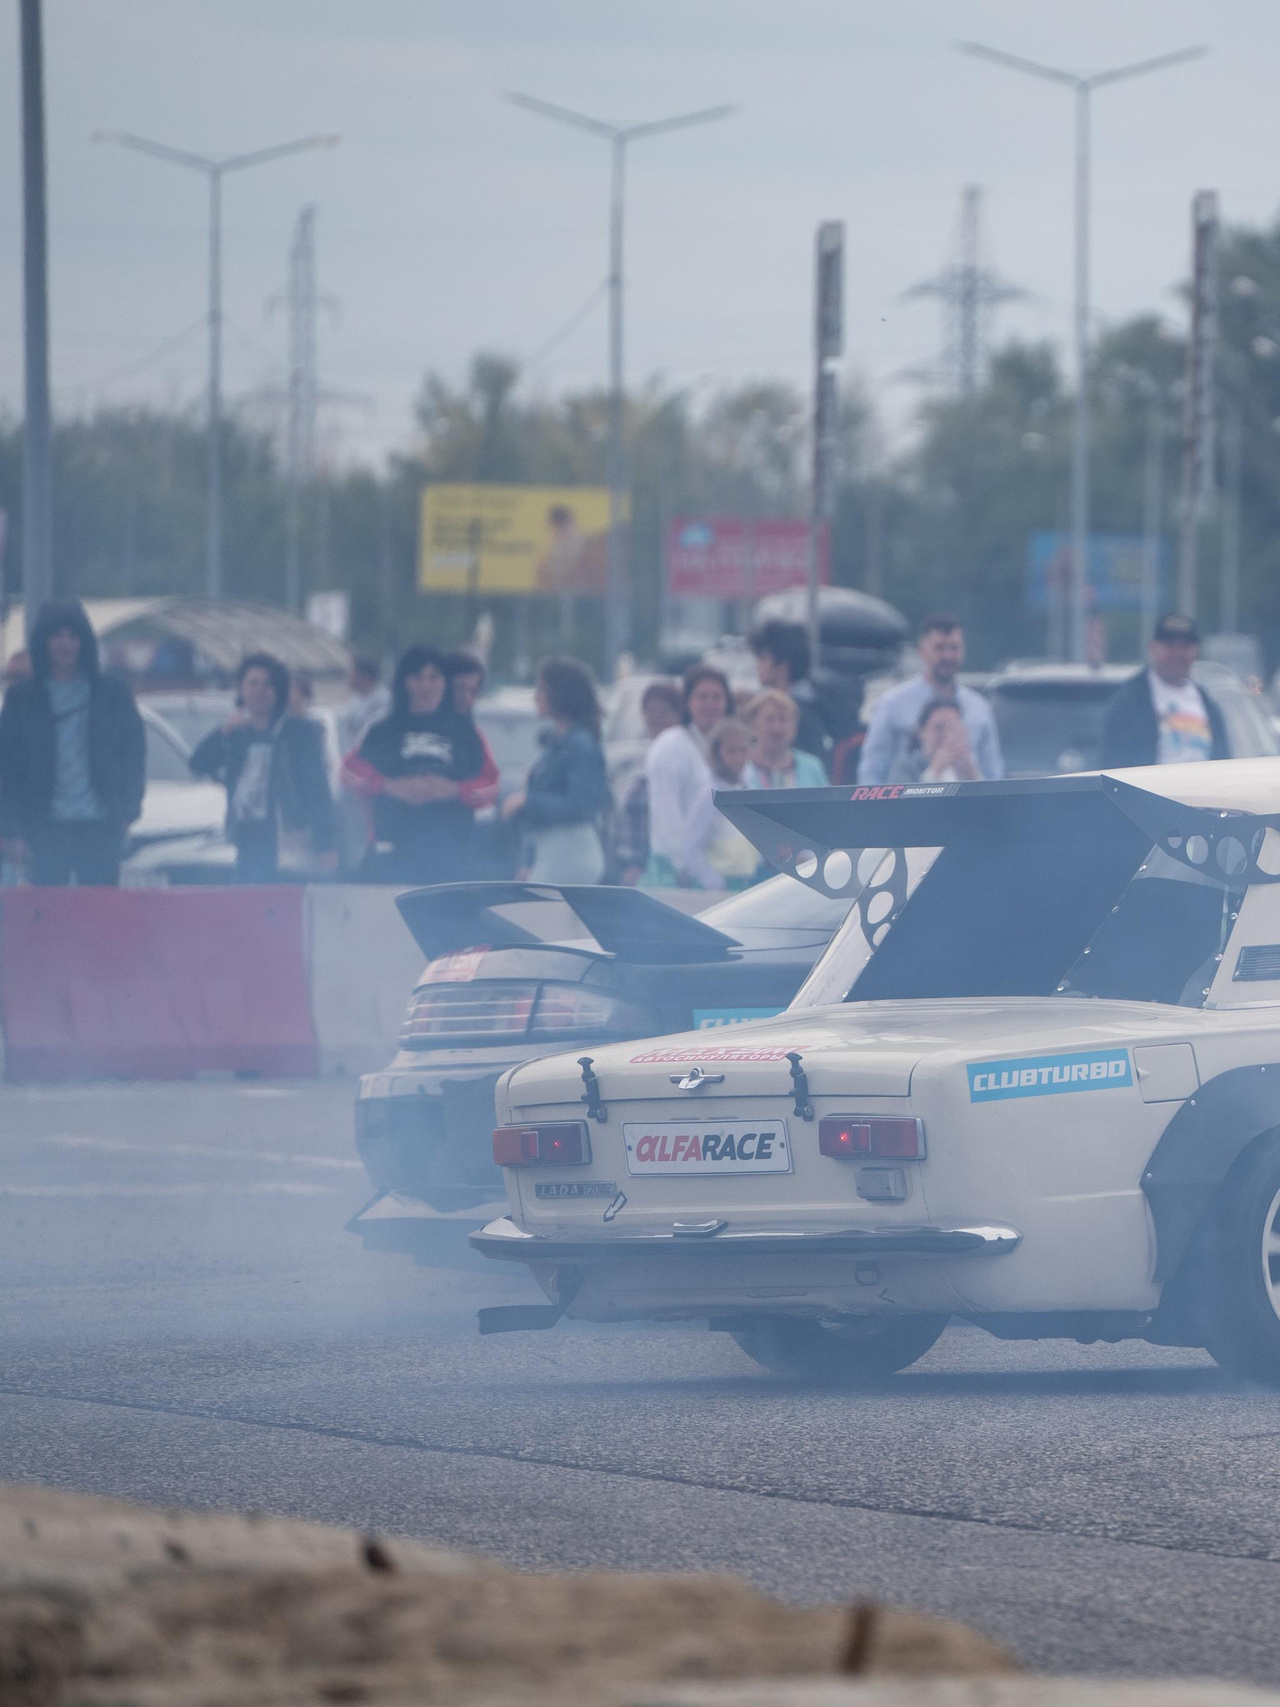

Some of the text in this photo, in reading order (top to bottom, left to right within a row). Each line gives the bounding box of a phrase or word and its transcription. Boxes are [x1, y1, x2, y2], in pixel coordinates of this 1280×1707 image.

[850, 785, 945, 801] RACE MONITOR
[632, 1053, 786, 1063] АВТОСИМУЛЯТОРЫ
[973, 1059, 1127, 1092] CLUBTURBO
[541, 1184, 579, 1196] LADA
